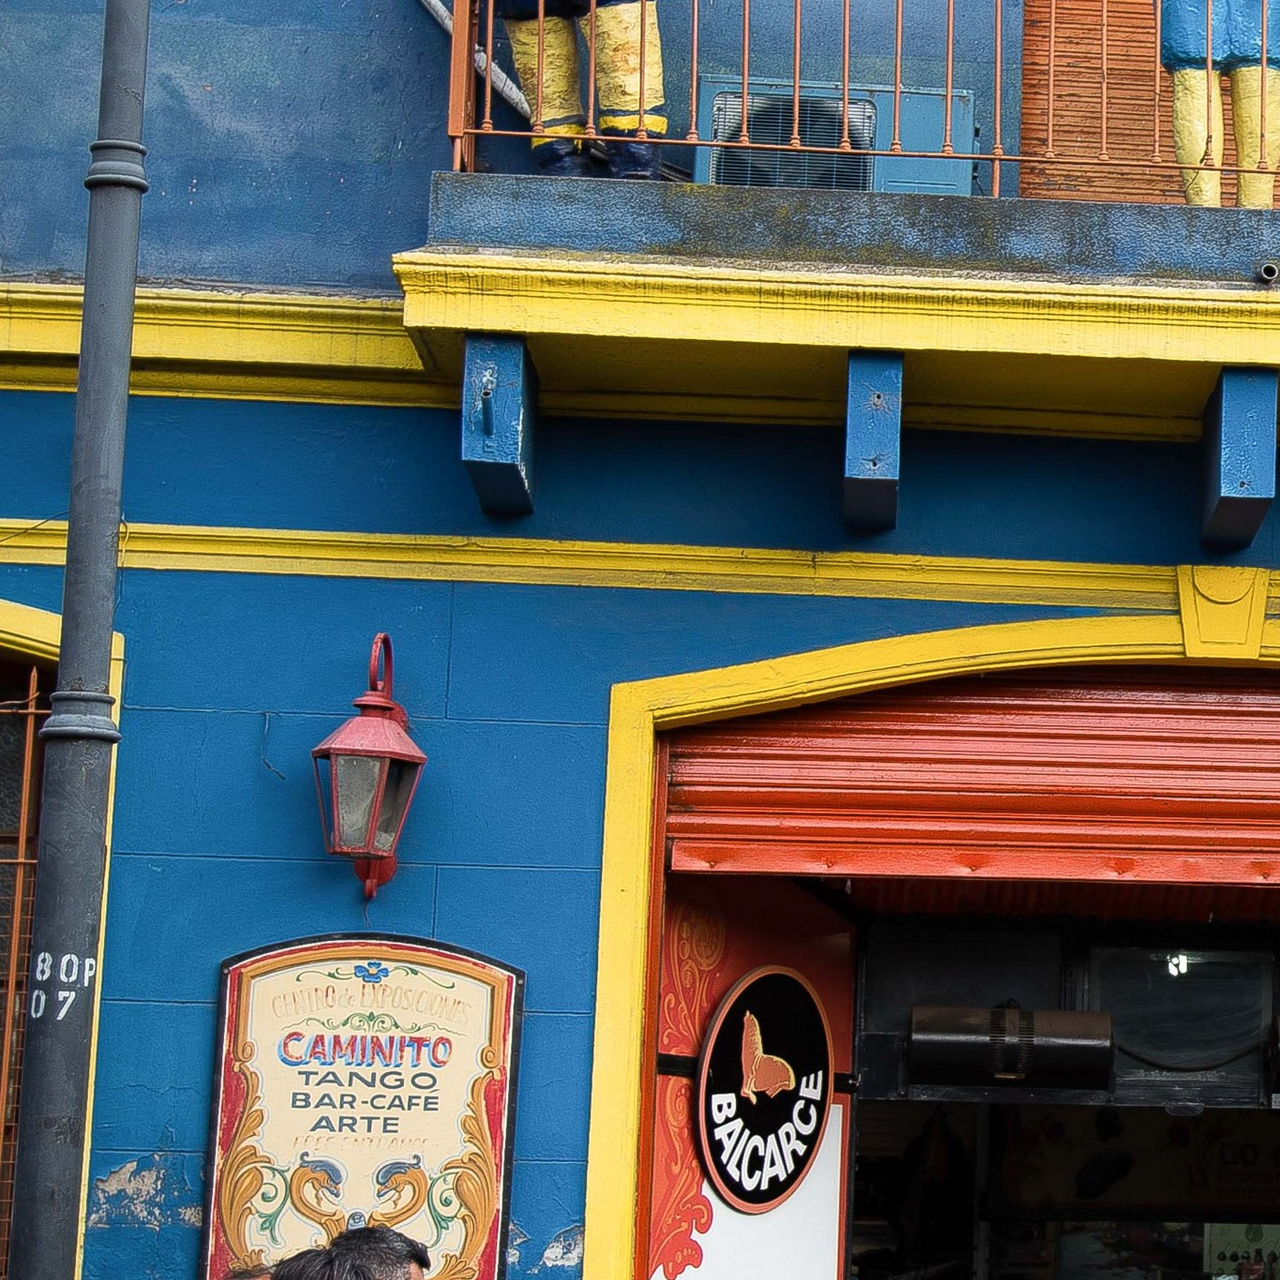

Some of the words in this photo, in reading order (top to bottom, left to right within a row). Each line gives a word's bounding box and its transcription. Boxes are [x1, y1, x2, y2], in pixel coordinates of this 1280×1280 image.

[31, 989, 76, 1020] 07
[277, 1031, 453, 1069] CAMINITO
[297, 1070, 438, 1090] TANGO
[291, 1089, 440, 1111] BAR-CAFÉ
[309, 1115, 399, 1133] ARTE
[711, 1069, 824, 1191] BALCARCE
